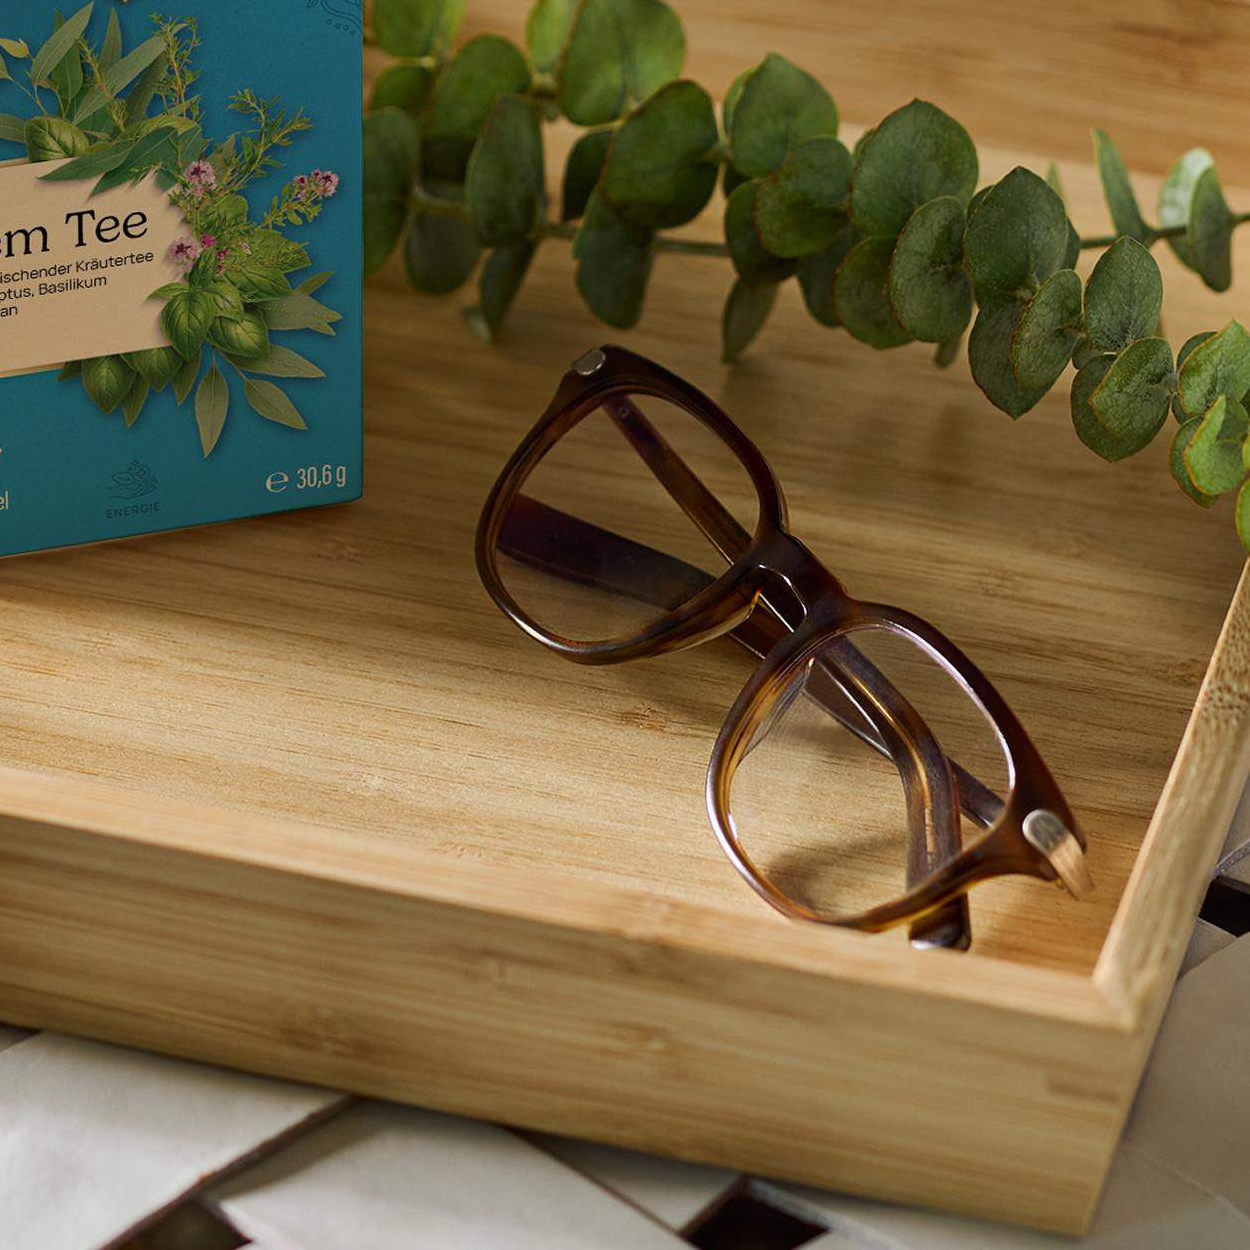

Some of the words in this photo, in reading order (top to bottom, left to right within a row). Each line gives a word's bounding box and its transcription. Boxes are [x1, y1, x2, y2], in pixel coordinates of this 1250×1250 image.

[64, 209, 149, 248] Tee
[75, 252, 154, 273] Kräutertee
[39, 276, 107, 296] Basilikum
[296, 464, 333, 490] 30,6
[335, 465, 347, 488] g
[106, 502, 161, 519] ENERGIE
